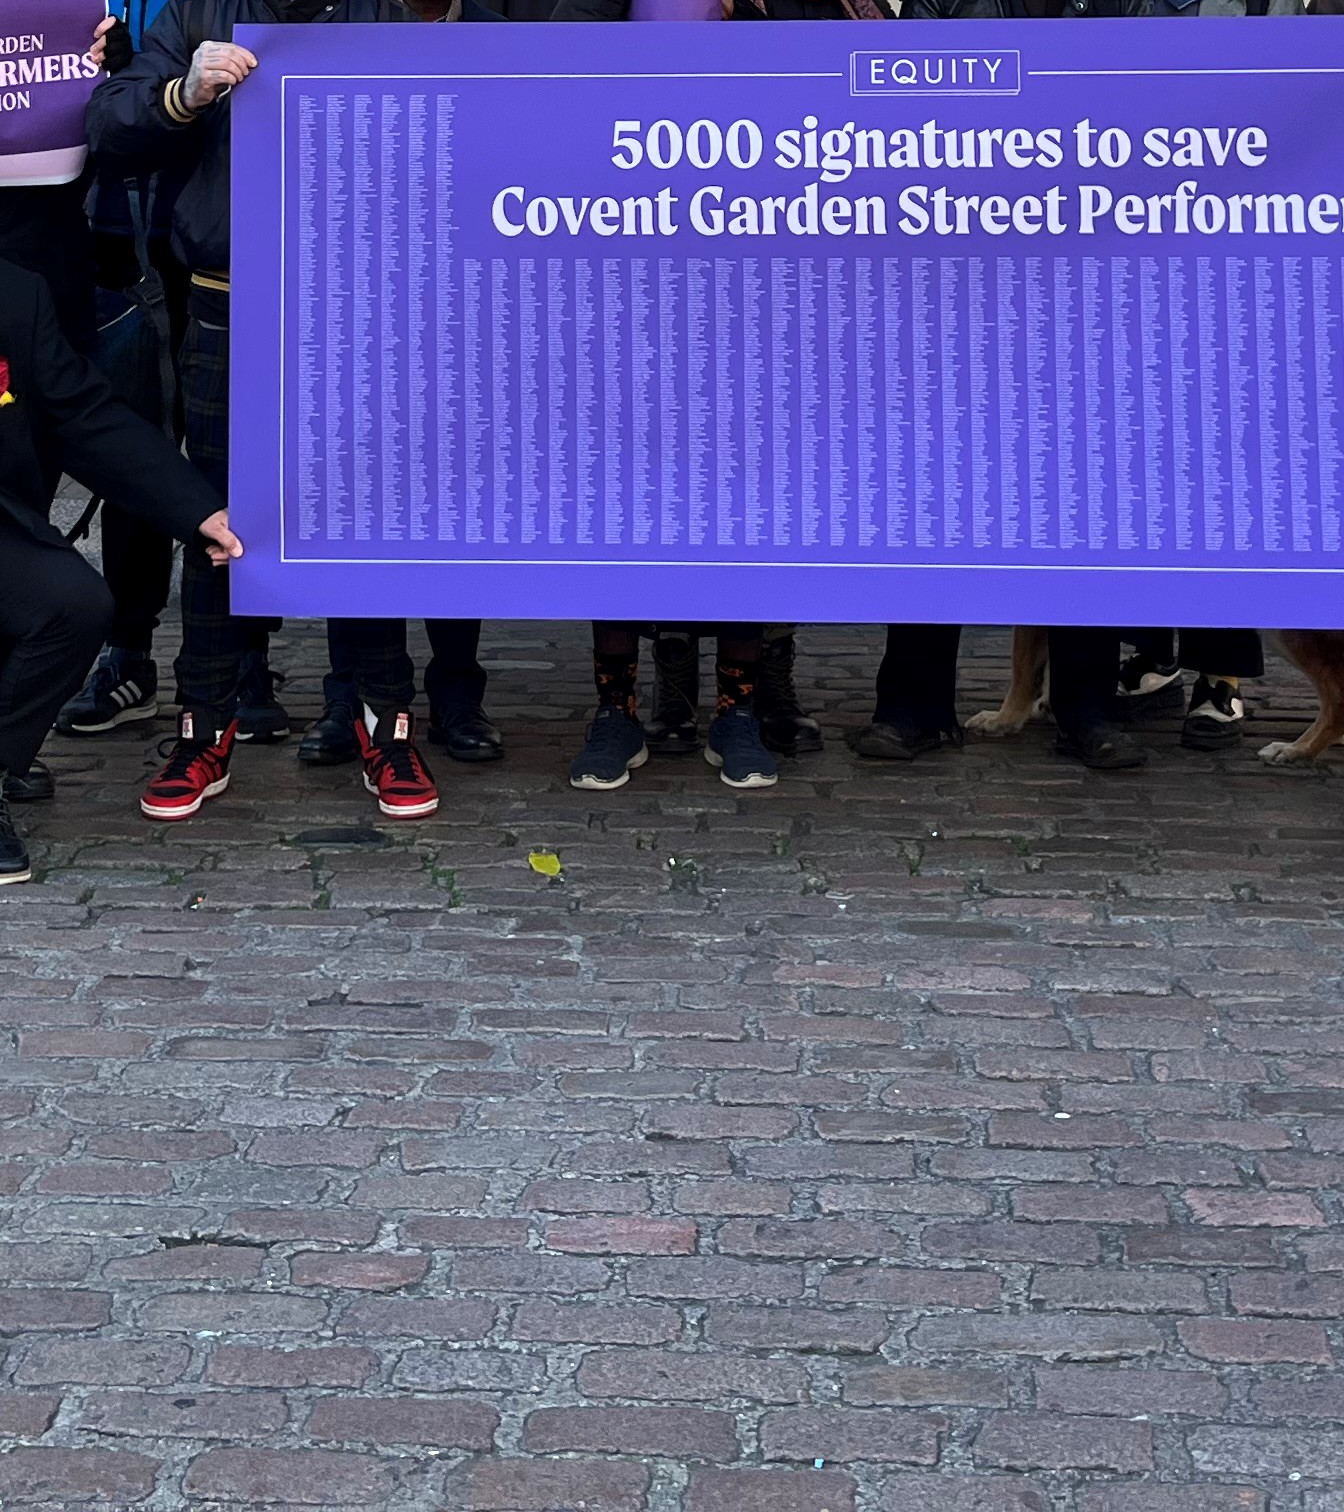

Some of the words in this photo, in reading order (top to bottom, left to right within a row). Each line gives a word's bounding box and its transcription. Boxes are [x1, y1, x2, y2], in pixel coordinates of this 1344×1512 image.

[869, 57, 1003, 85] EQUITY
[610, 118, 764, 170] 5000
[773, 114, 1064, 184] signatures
[1072, 117, 1132, 169] to
[1142, 125, 1268, 169] save
[491, 185, 679, 238] Covent
[689, 181, 887, 238] Garden
[897, 184, 1068, 237] Street
